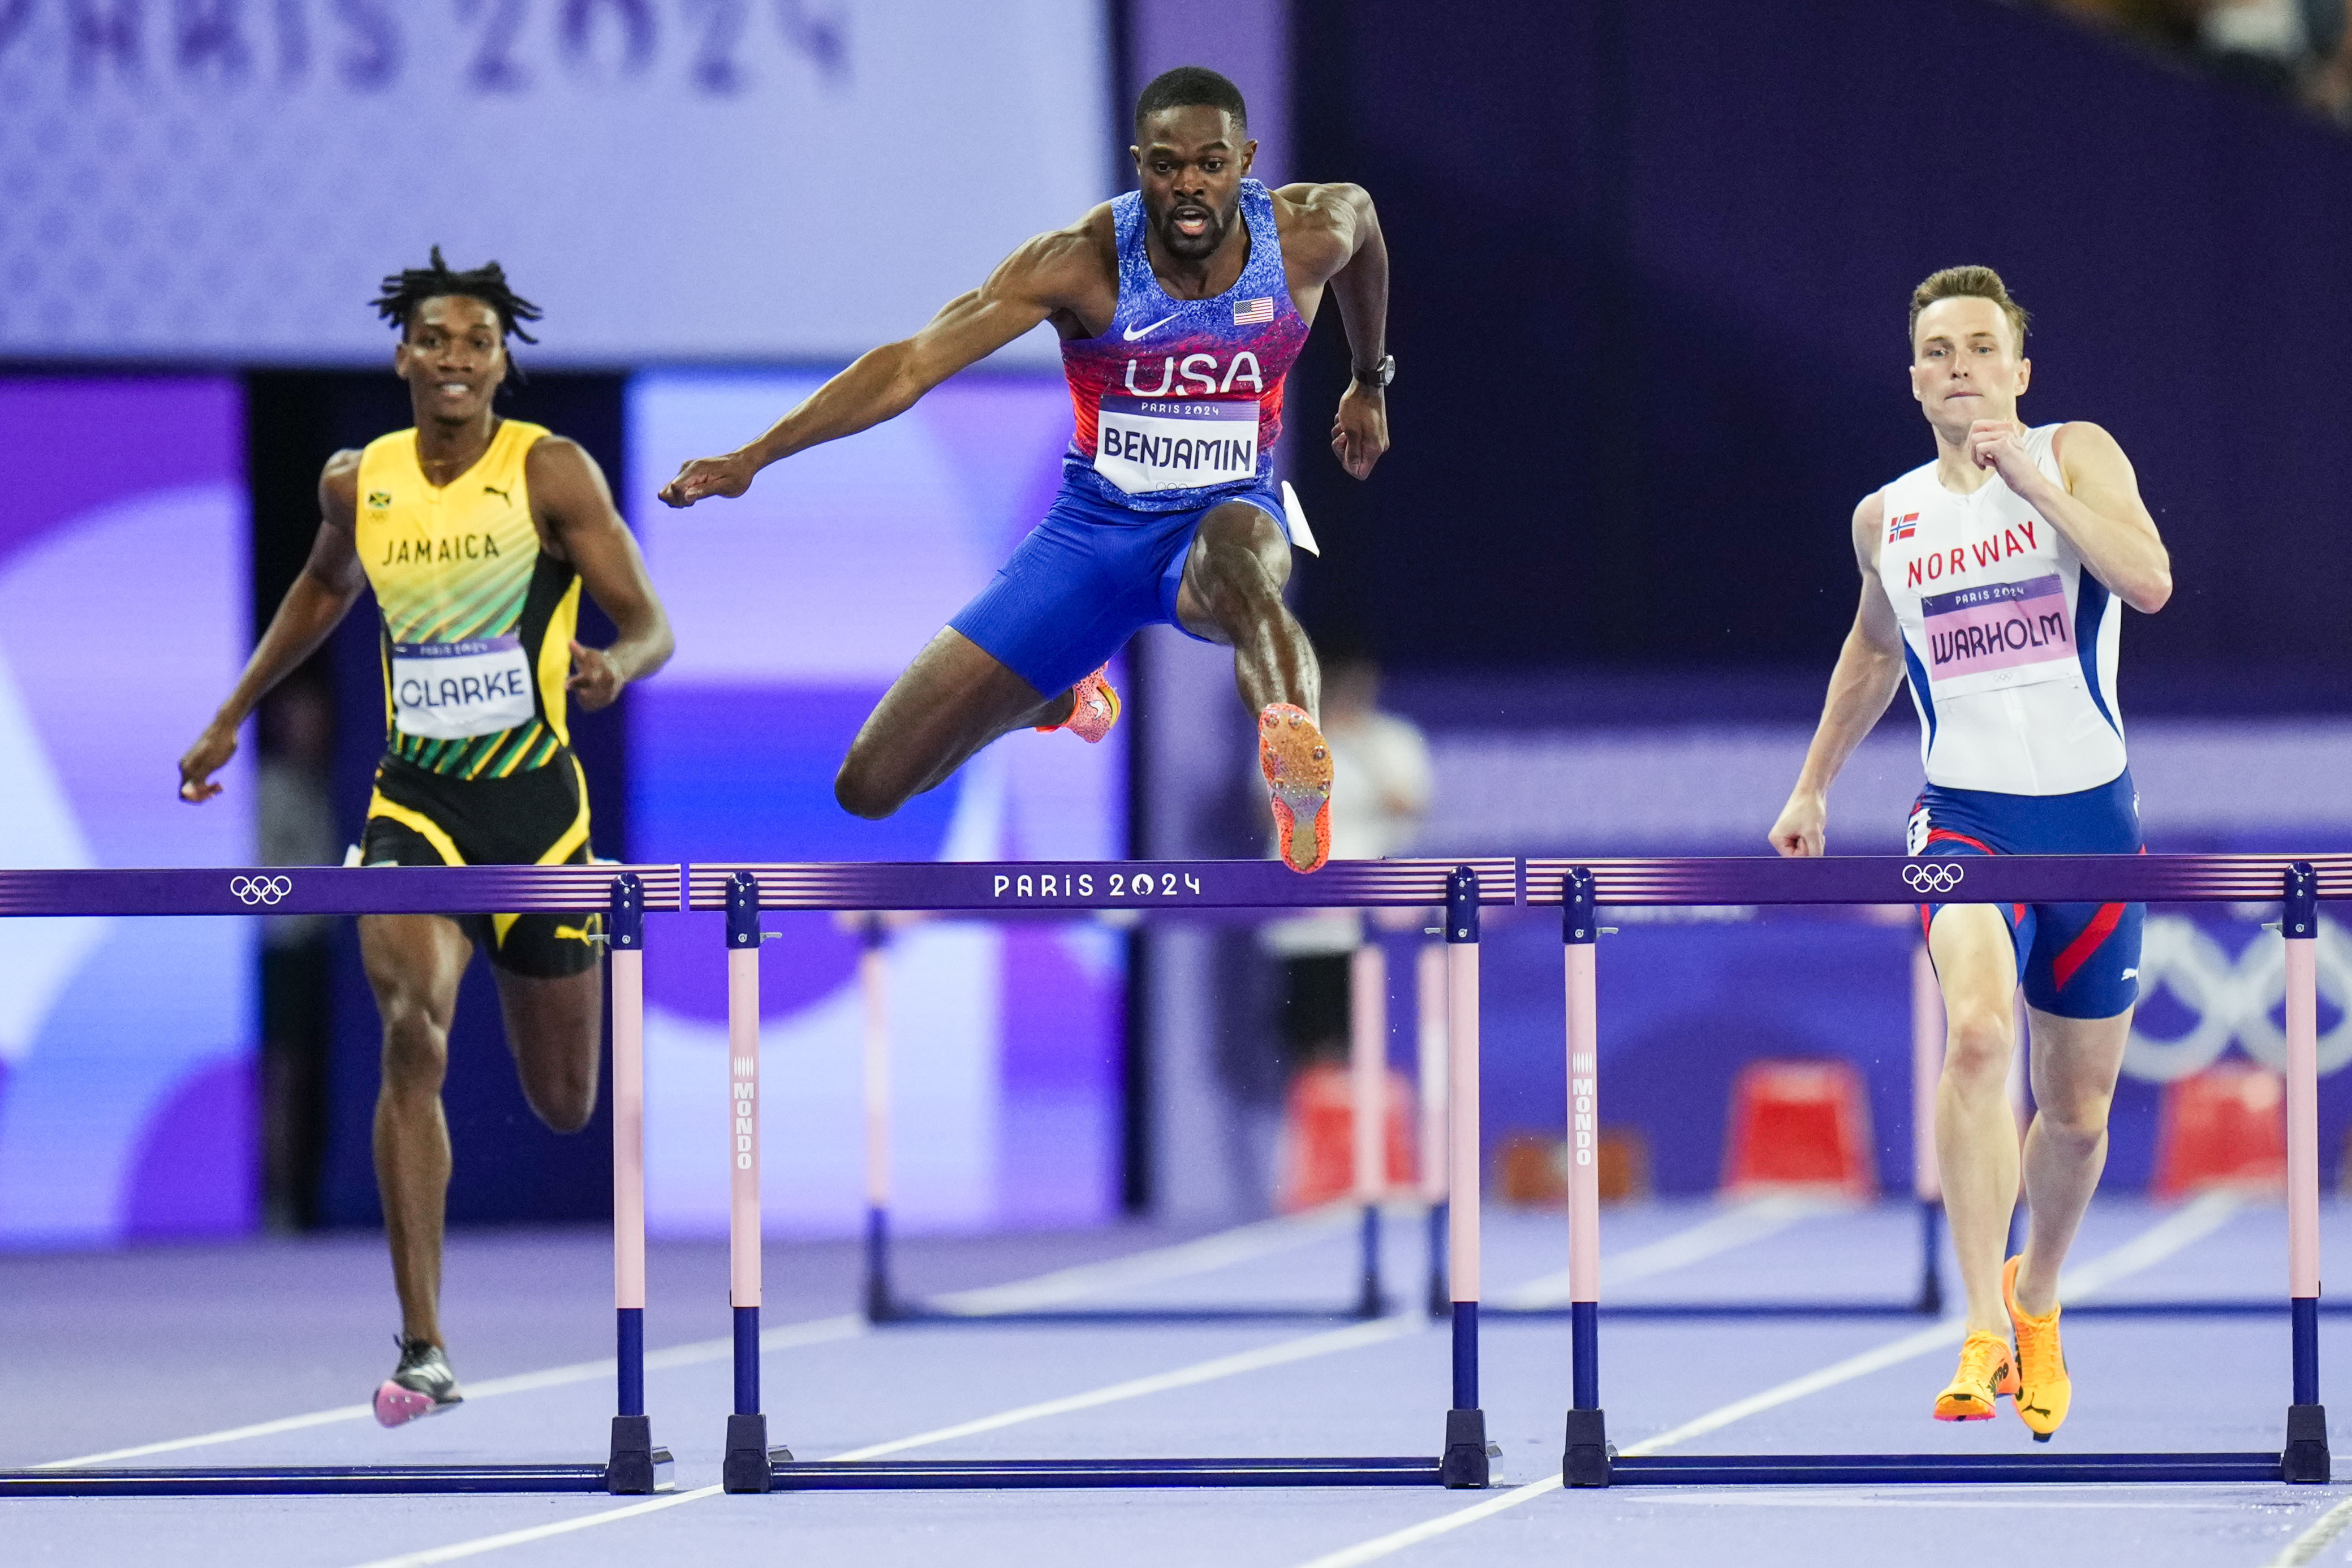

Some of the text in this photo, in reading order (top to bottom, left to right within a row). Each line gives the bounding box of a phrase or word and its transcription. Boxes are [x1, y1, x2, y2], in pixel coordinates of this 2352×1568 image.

[1125, 351, 1263, 397] USA
[1141, 402, 1219, 416] PARIS 2024
[1104, 427, 1251, 471] BENJAMIN
[382, 534, 499, 566] JAMAICA
[1909, 521, 2037, 588] NORWAY
[1955, 591, 1990, 605] PARIS
[1932, 612, 2067, 665] WARHOLM
[400, 668, 524, 707] CLARKE
[1109, 872, 1200, 896] 2024
[734, 1082, 754, 1170] MONDO
[1573, 1078, 1593, 1166] MONDO
